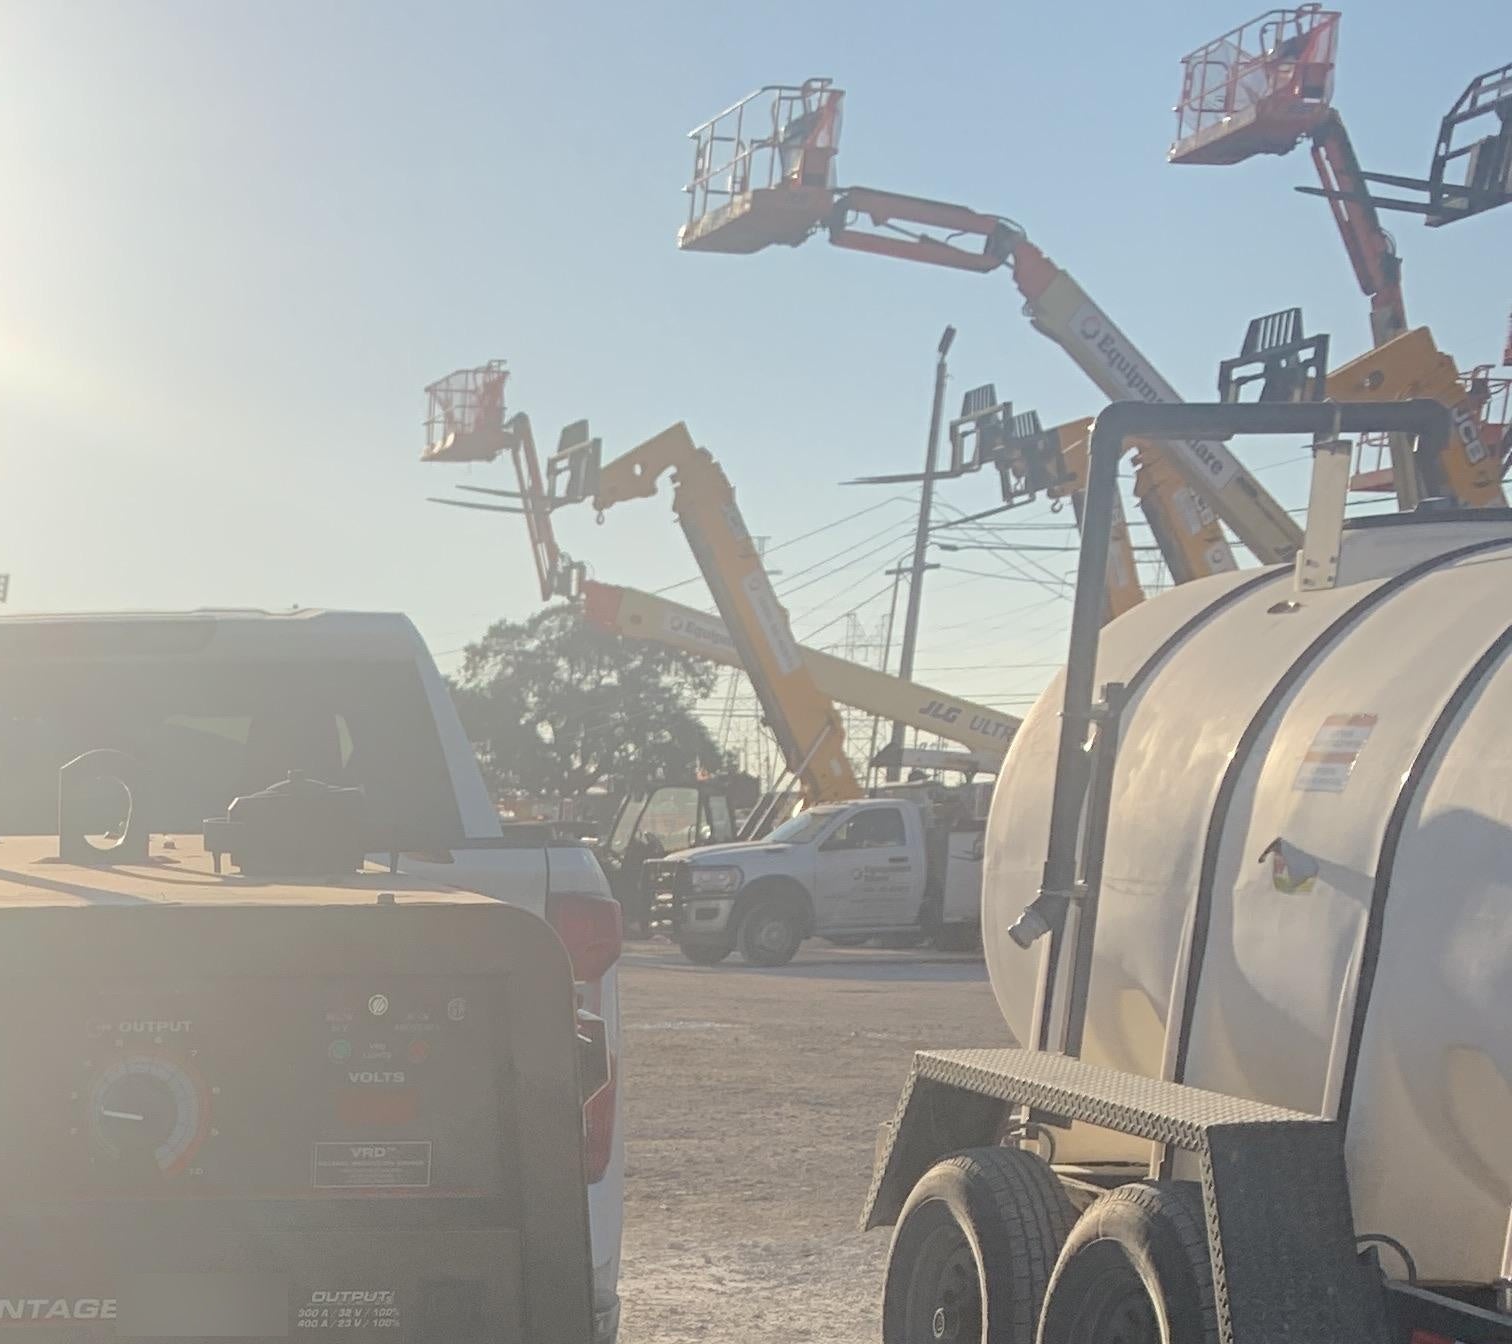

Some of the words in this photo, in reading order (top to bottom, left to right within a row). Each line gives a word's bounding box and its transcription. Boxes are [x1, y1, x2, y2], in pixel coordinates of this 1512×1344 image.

[919, 700, 962, 723] JLG
[969, 714, 1016, 742] ULTR
[119, 1020, 193, 1033] OUTPUT
[348, 1071, 406, 1084] VOLTS
[311, 1290, 392, 1303] OUTPUT
